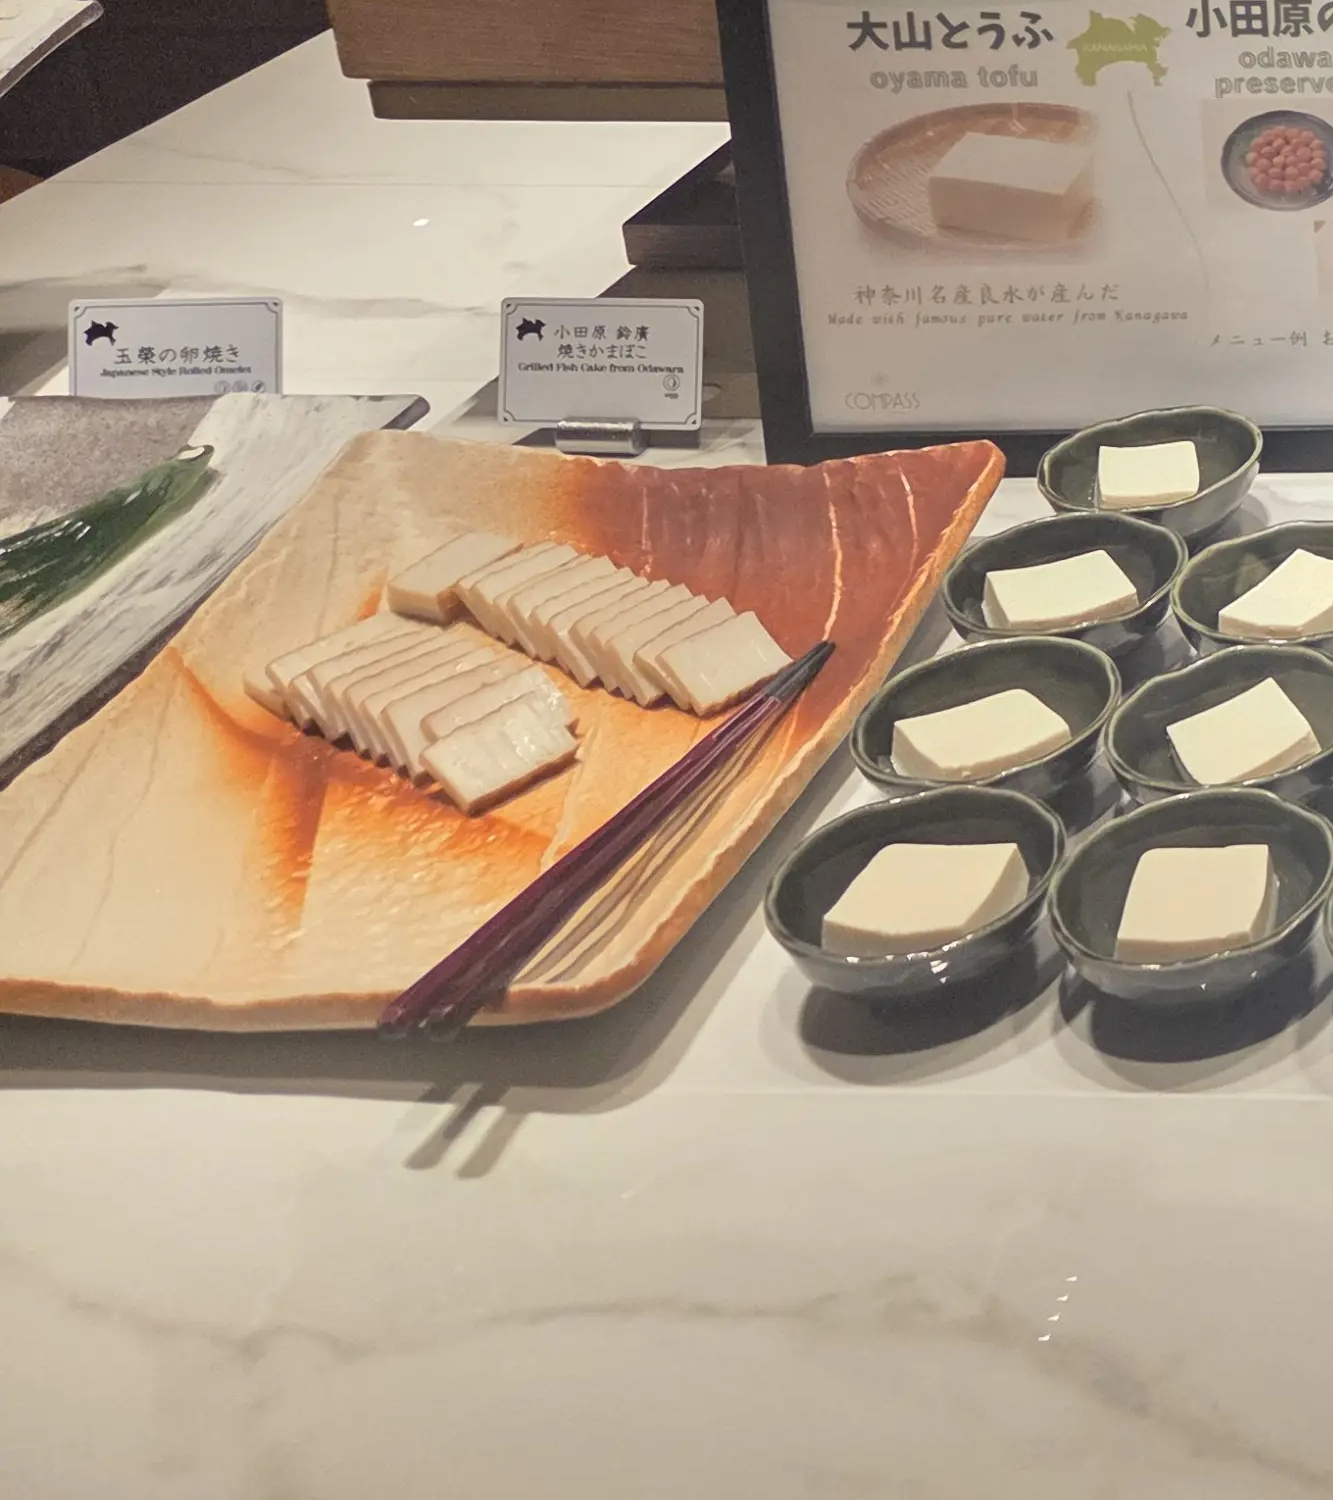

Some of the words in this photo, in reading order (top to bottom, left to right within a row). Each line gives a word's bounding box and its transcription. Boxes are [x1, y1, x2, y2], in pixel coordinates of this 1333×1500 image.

[846, 11, 1054, 50] 大山とうふ
[870, 69, 968, 94] oyama
[977, 64, 1038, 87] tofu
[852, 282, 1120, 306] 神奈川名産良水が産んだ
[872, 311, 905, 326] with
[914, 312, 967, 328] famous
[977, 312, 1013, 327] pure
[1022, 311, 1064, 323] water
[1072, 308, 1107, 325] from
[1114, 308, 1189, 325] Kanagawa
[554, 325, 608, 340] 小田原
[1209, 329, 1308, 348] メニュー例
[557, 343, 647, 359] 焼きかまぼこ
[100, 368, 149, 378] Japanese
[152, 368, 177, 377] Style
[179, 367, 212, 376] Rolled
[214, 366, 251, 374] Omelet
[518, 362, 553, 372] Grilled
[556, 363, 578, 372] Fish
[580, 363, 604, 372] Cake
[608, 363, 634, 373] from
[637, 365, 684, 374] Odawara
[845, 392, 921, 411] COMPASS
